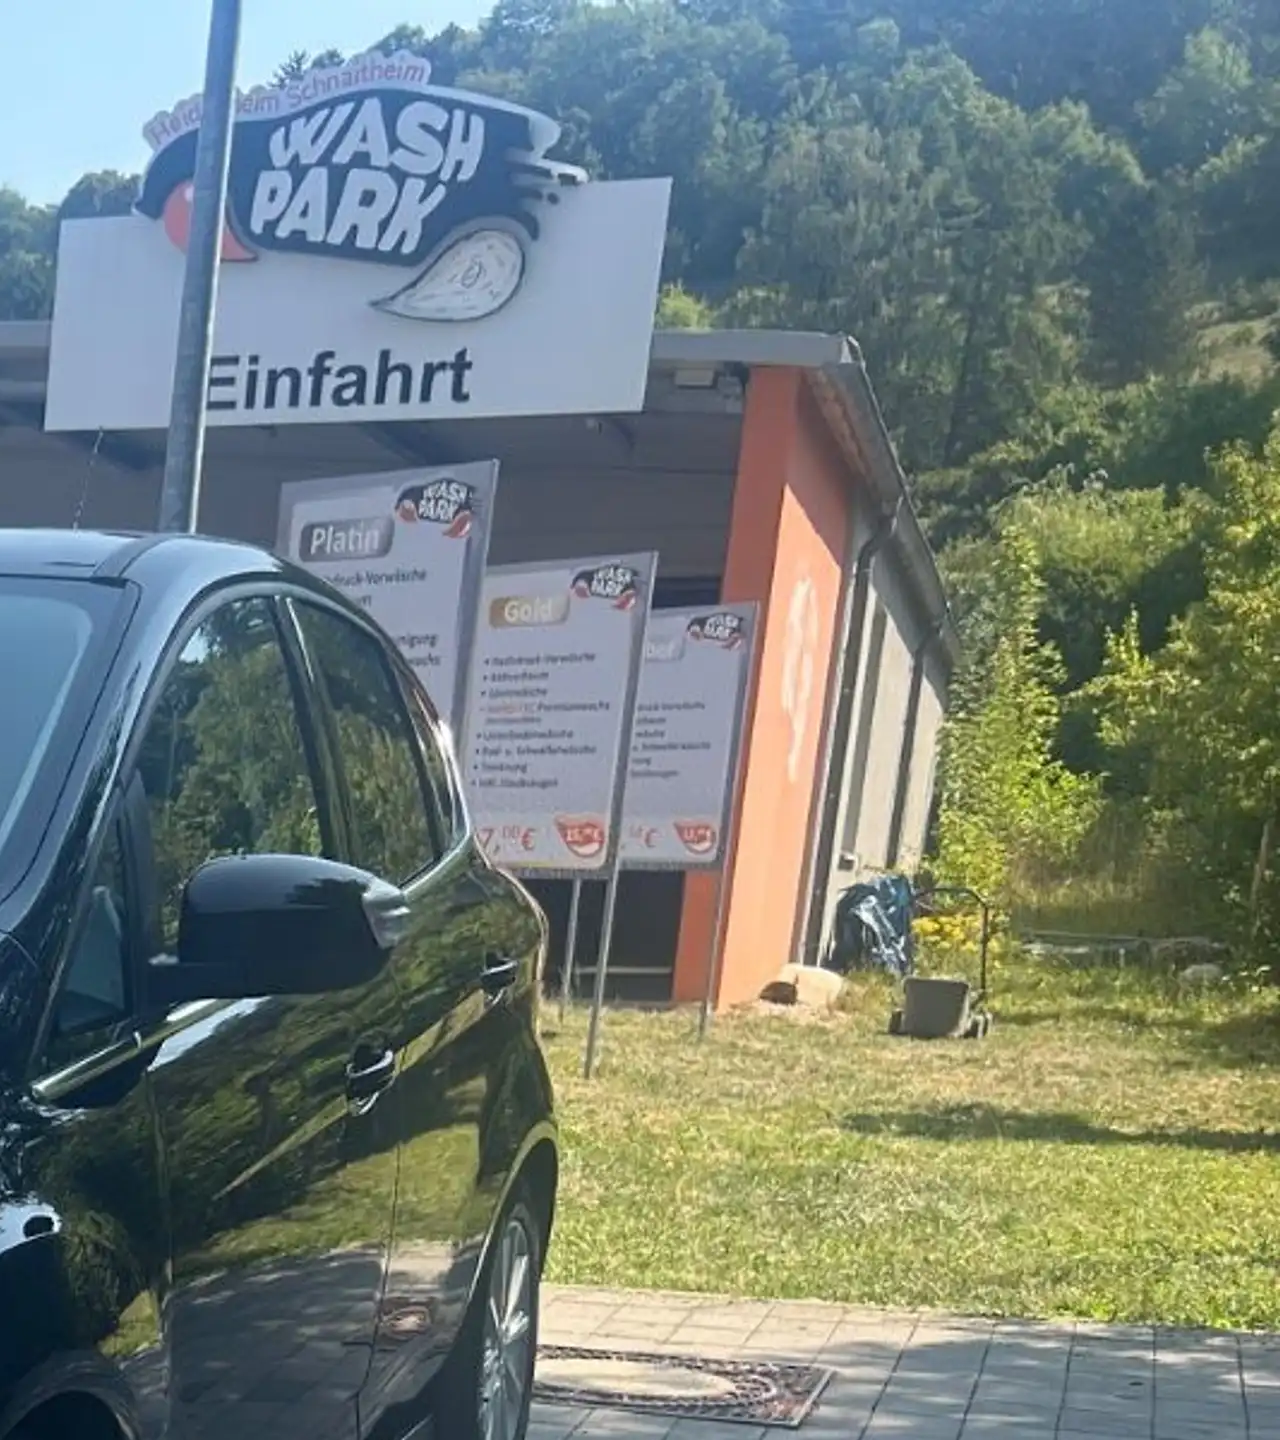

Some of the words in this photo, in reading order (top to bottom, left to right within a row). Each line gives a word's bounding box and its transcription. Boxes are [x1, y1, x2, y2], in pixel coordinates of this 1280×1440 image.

[288, 62, 425, 107] Schnaitheim
[269, 97, 485, 183] WASH
[250, 166, 446, 255] PARK
[206, 347, 473, 411] Einfahrt
[310, 521, 380, 555] Platin
[503, 597, 552, 624] Gold
